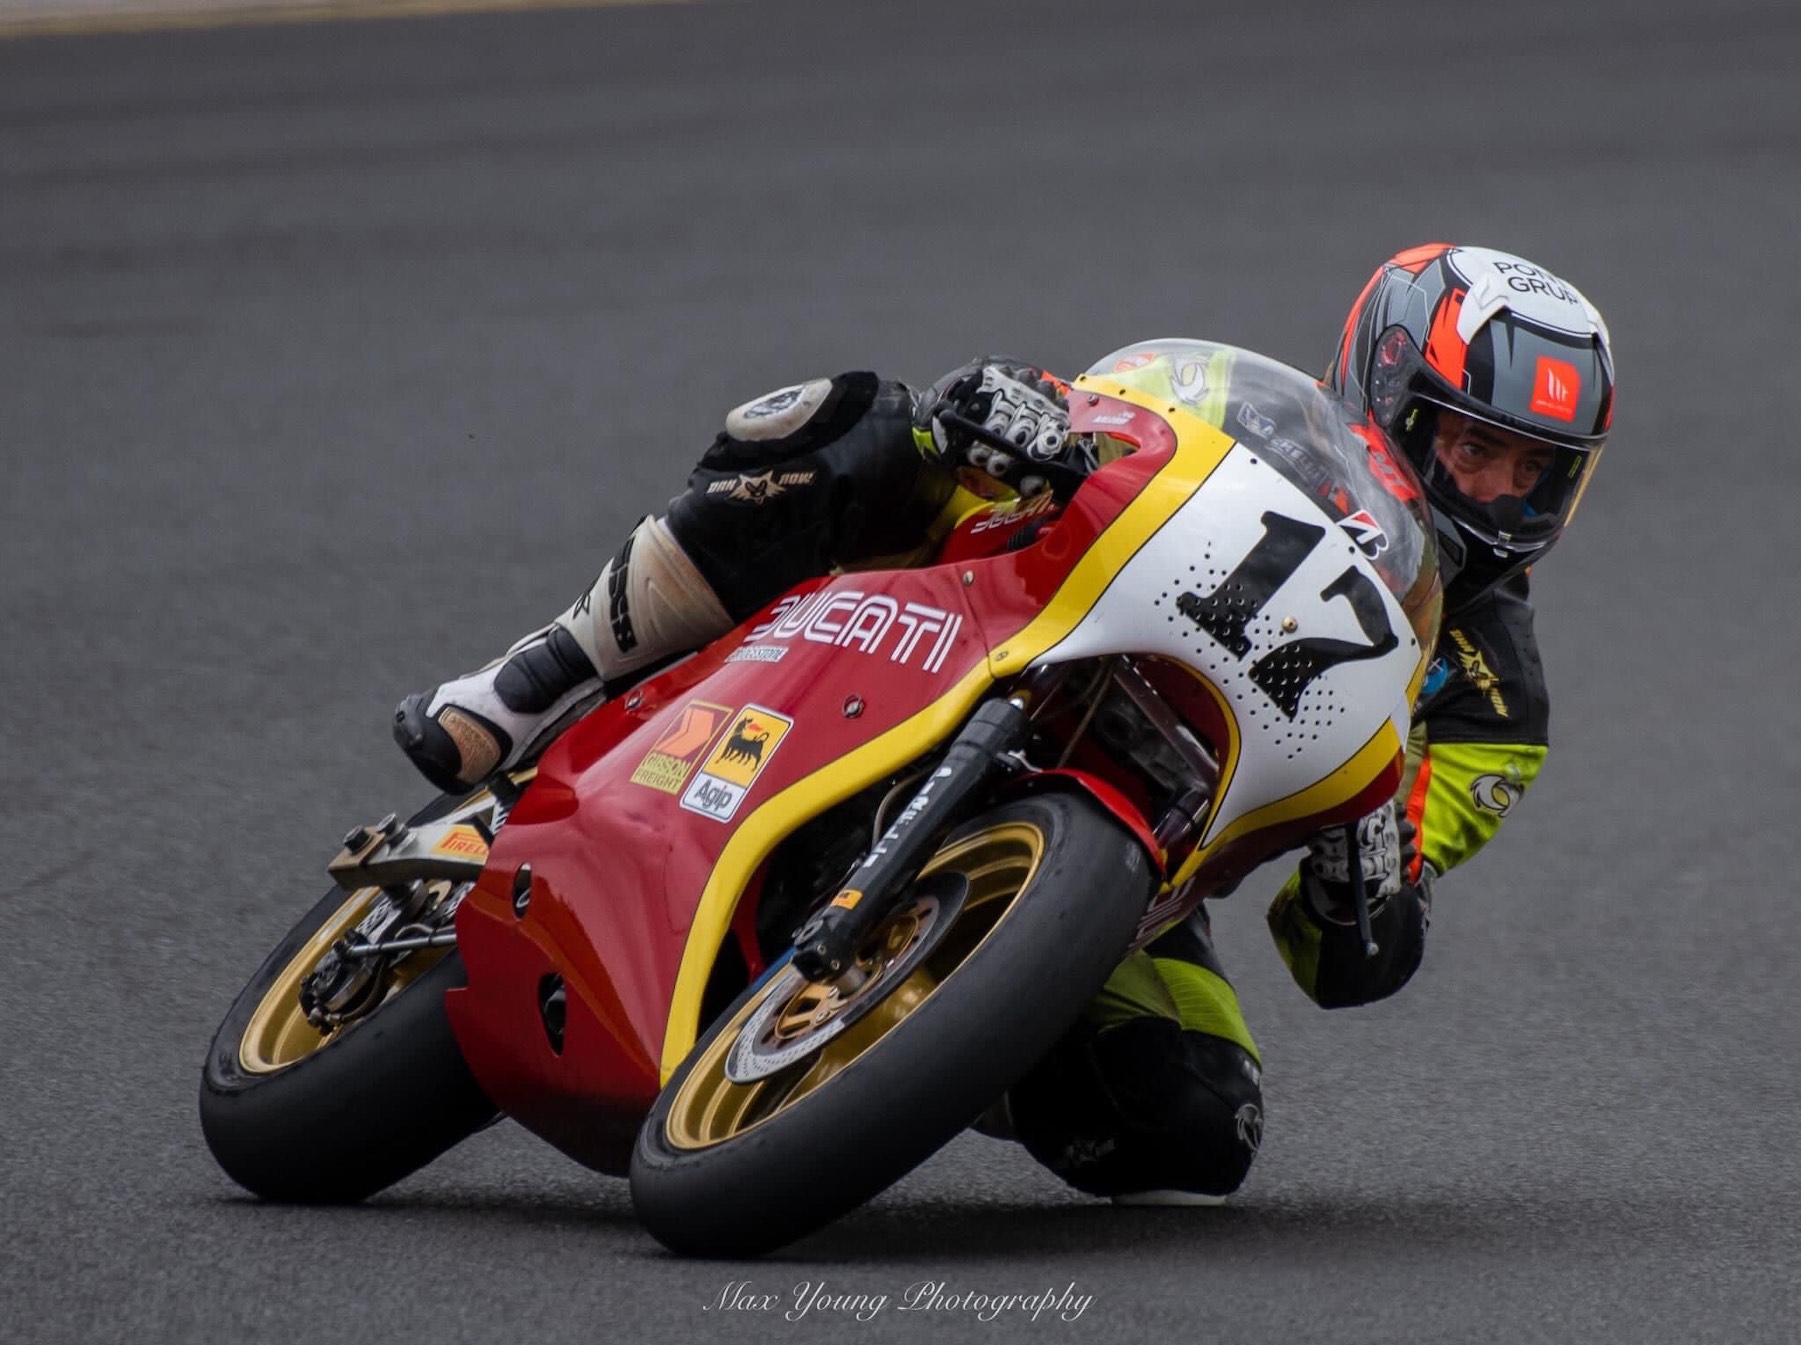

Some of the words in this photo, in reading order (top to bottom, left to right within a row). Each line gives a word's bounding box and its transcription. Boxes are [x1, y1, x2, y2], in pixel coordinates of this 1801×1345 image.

[1175, 510, 1399, 720] 17
[743, 591, 963, 674] DUCATI
[634, 769, 680, 790] FREIGHT
[643, 751, 692, 777] GIBSON
[694, 779, 733, 811] Agip
